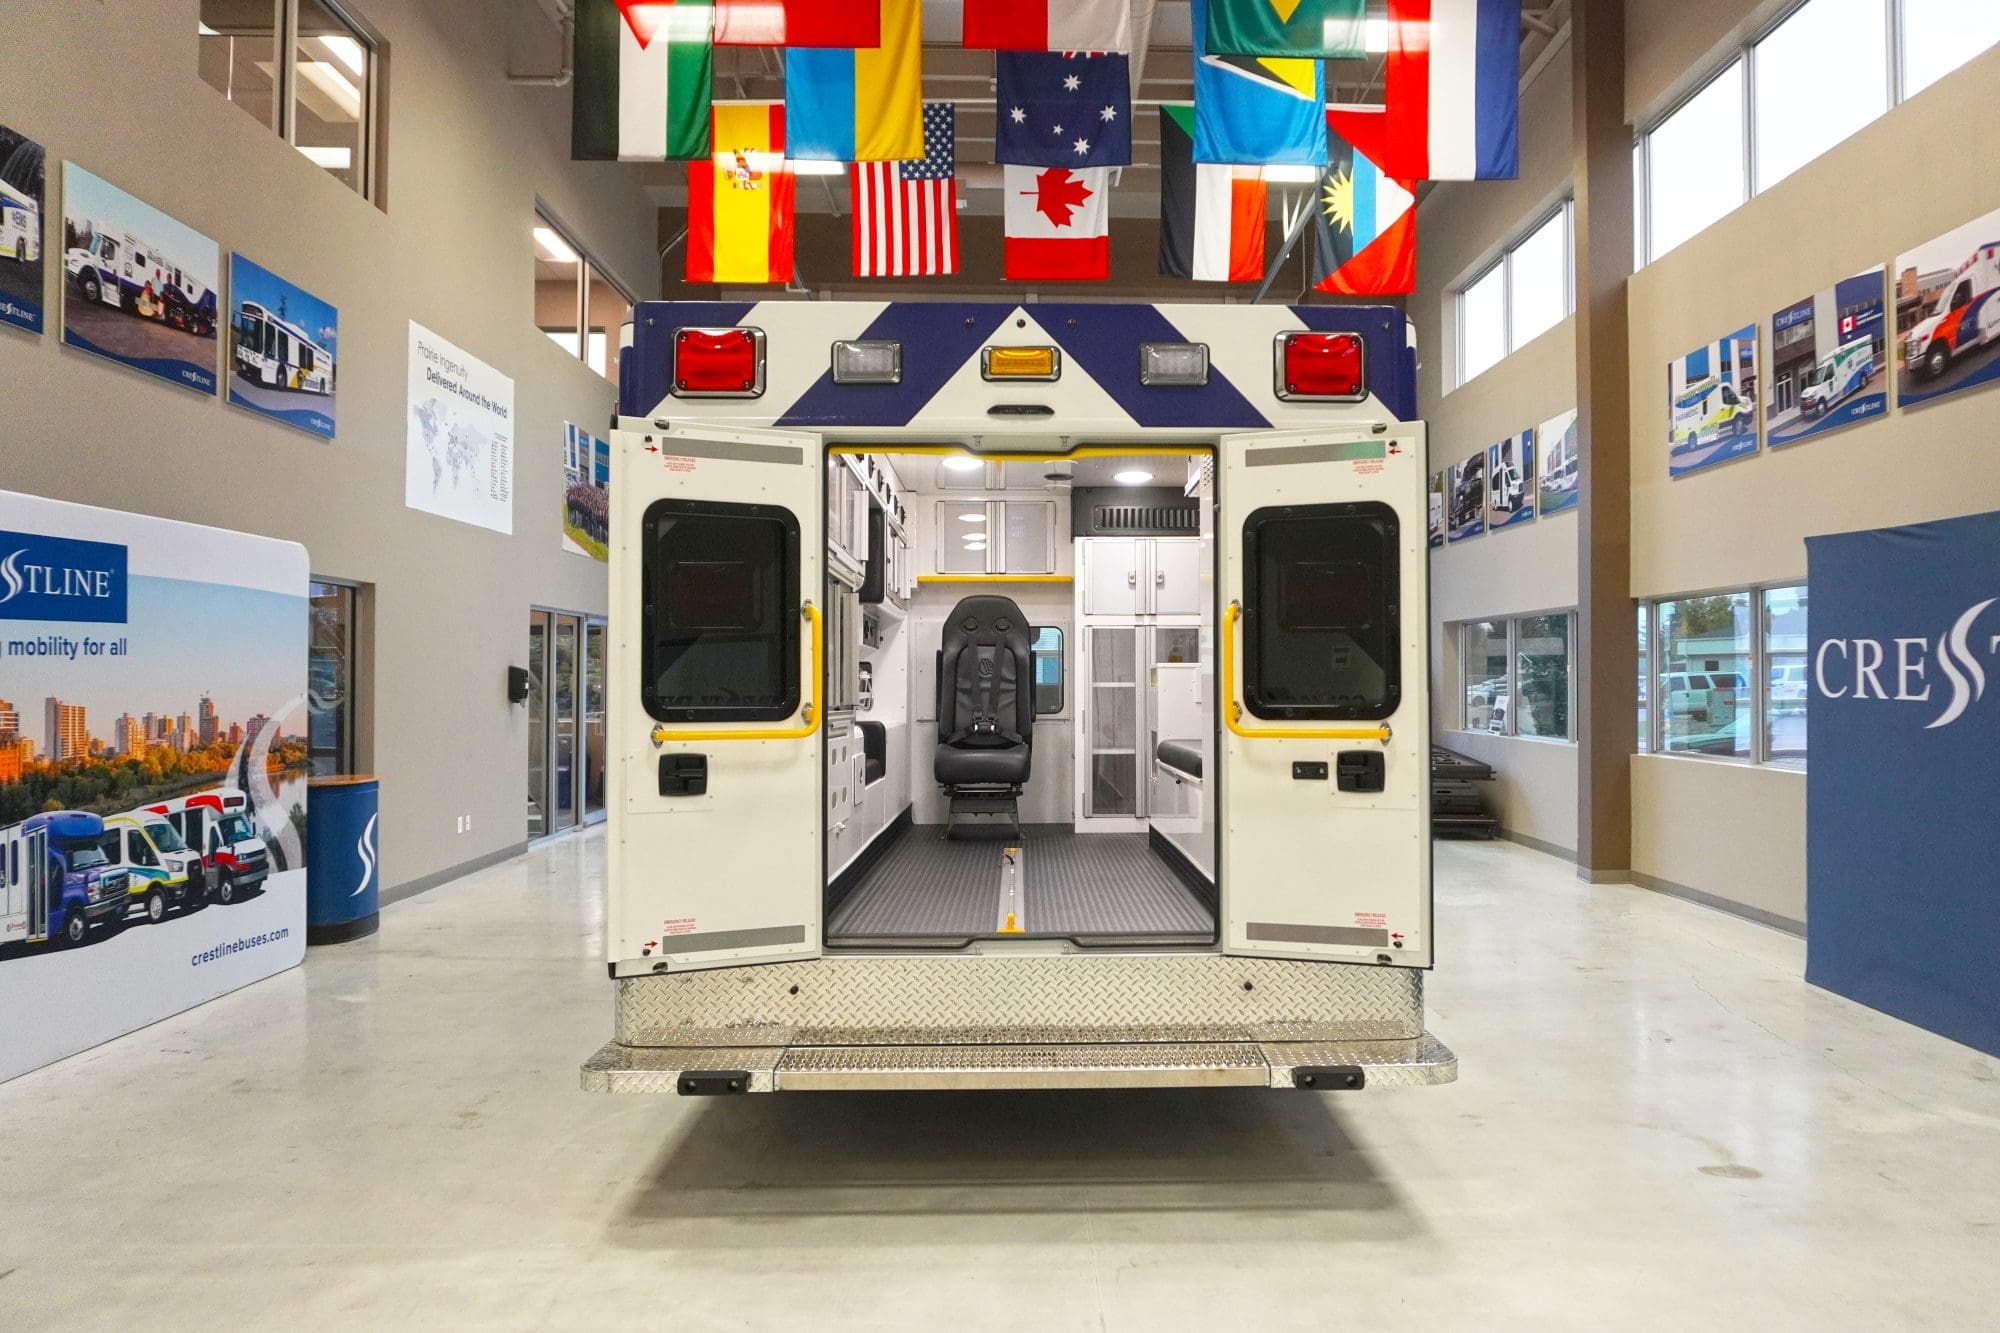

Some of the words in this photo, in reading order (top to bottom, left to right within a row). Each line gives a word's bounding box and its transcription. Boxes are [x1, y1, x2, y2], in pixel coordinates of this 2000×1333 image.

[417, 341, 438, 363] Prairie
[440, 352, 468, 382] Ingenuity
[182, 370, 211, 386] CRESTLINE
[426, 366, 457, 394] Delivered
[459, 385, 481, 405] Around
[481, 395, 491, 410] the
[491, 401, 507, 418] World
[1851, 399, 1880, 416] CRESTLINE
[8, 636, 79, 660] mobility
[83, 637, 105, 655] for
[109, 638, 127, 655] all
[191, 927, 289, 967] crestlinebuses.com
